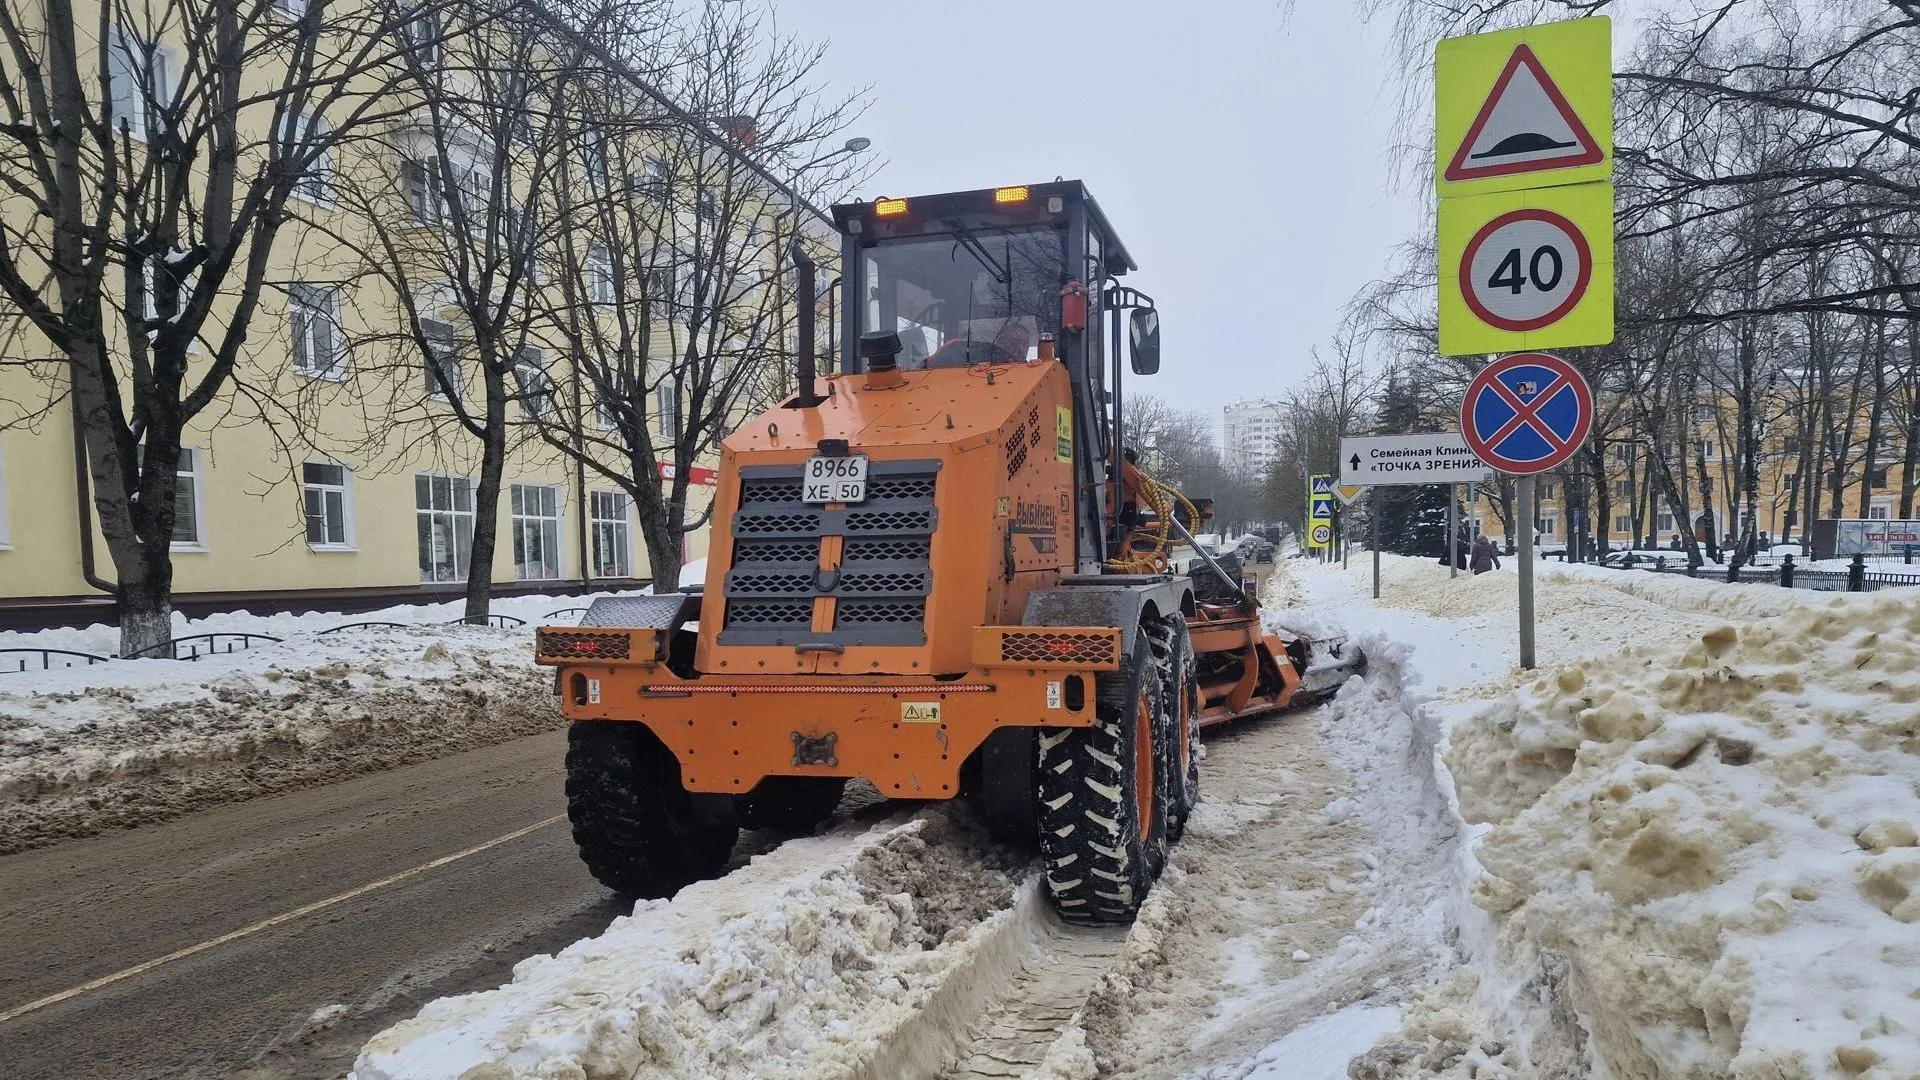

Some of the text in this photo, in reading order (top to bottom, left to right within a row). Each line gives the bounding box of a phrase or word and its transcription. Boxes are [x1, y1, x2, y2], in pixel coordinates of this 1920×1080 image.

[1488, 245, 1563, 295] 40
[1370, 447, 1432, 459] Семейная
[812, 460, 859, 478] 8966
[1370, 461, 1421, 472] «ТОЧКА
[807, 484, 860, 499] ХЕ 50
[1316, 530, 1328, 539] 20
